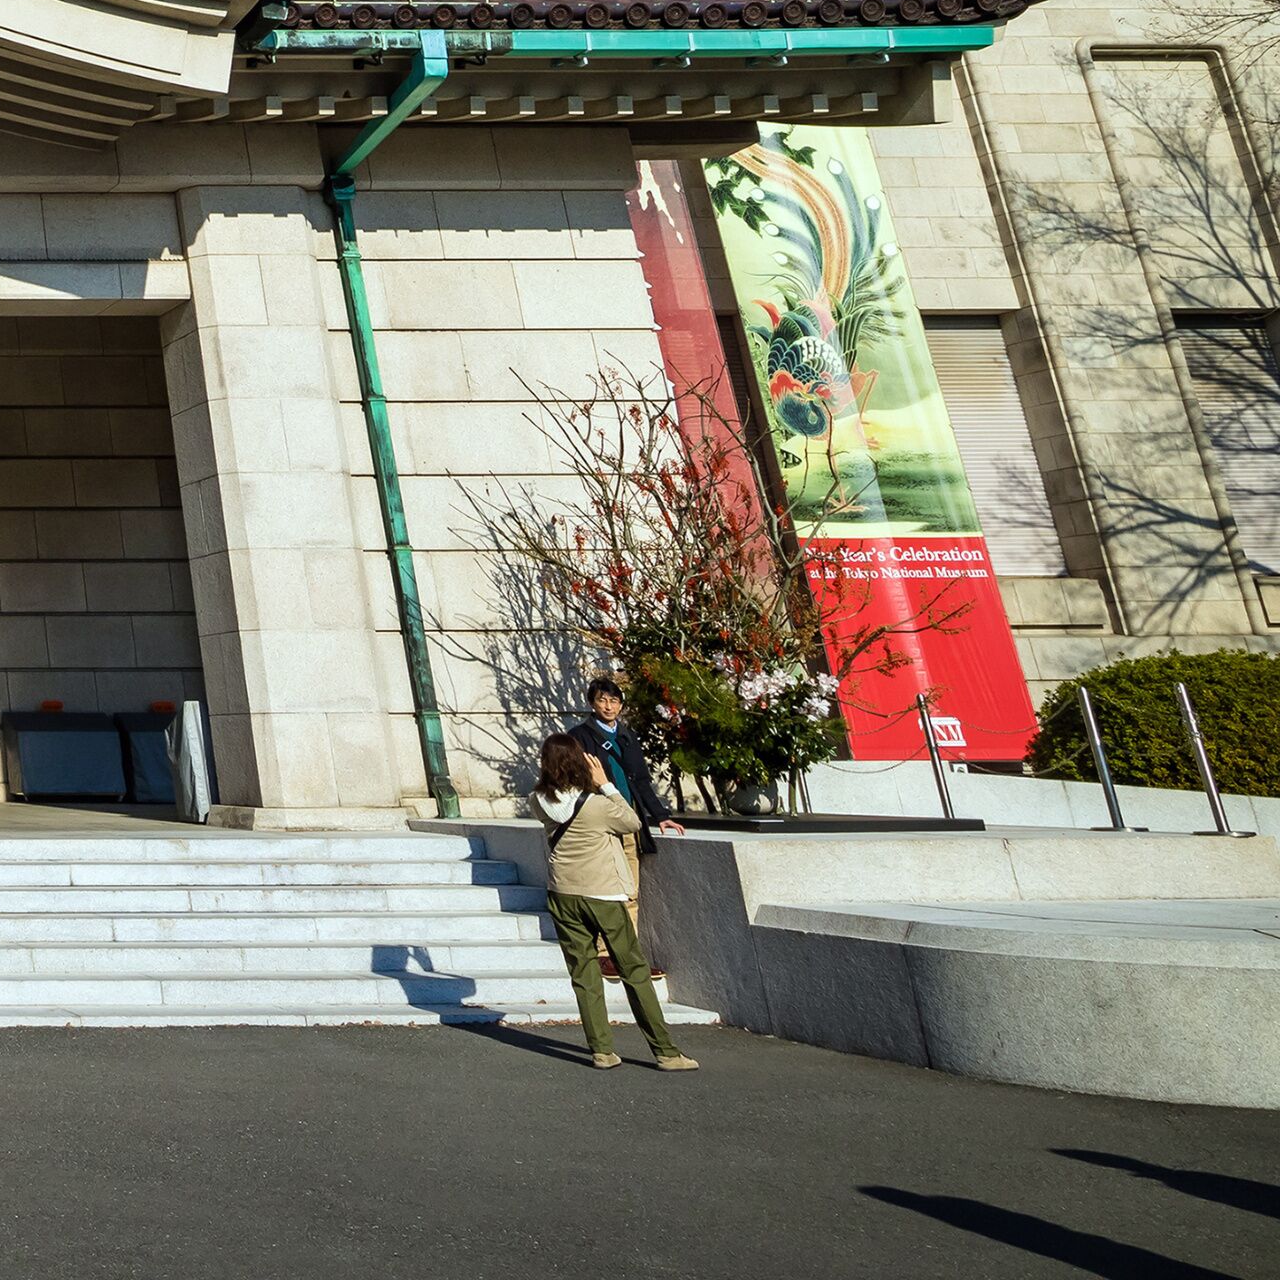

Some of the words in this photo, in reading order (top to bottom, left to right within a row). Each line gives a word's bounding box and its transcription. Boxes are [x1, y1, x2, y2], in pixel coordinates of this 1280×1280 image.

[840, 547, 886, 562] Year's
[889, 546, 984, 562] Celebration
[842, 567, 879, 582] Tokyo
[880, 566, 934, 578] National
